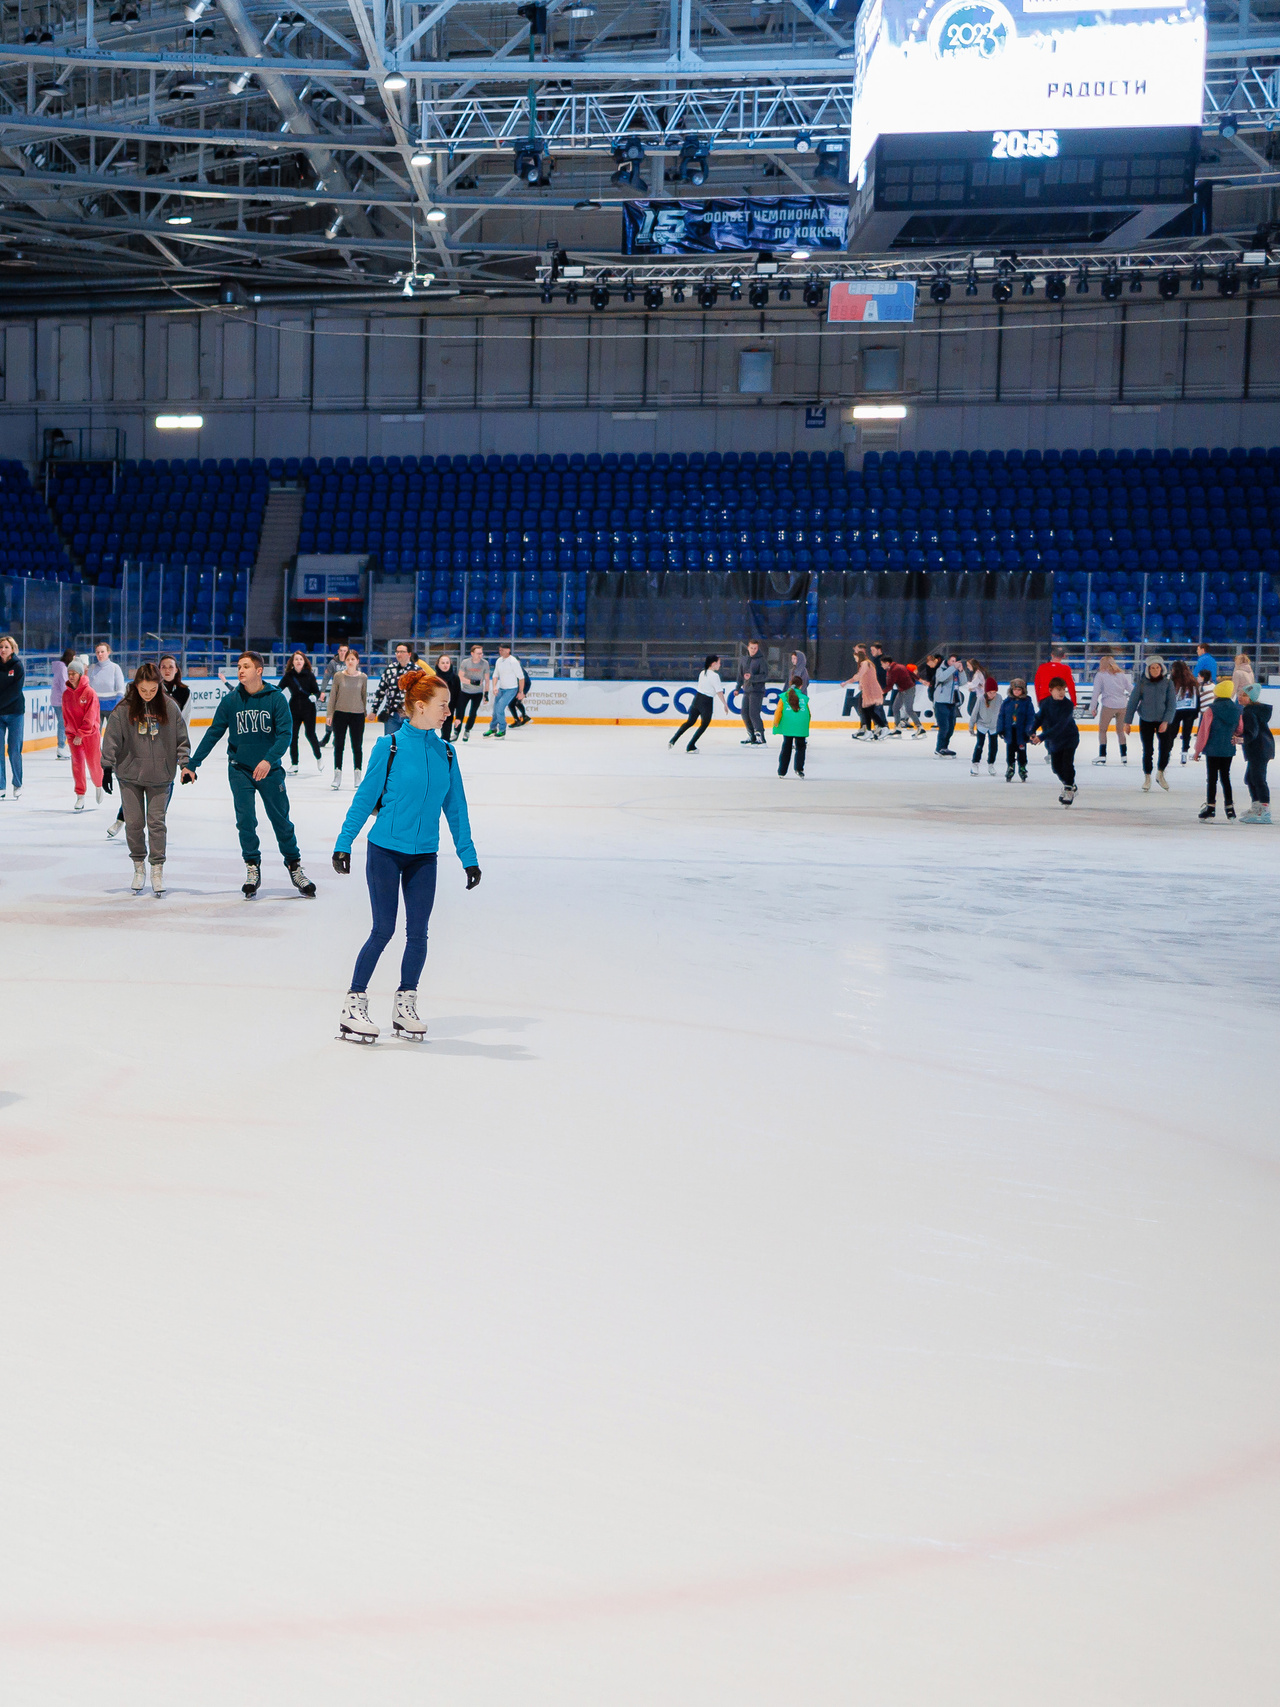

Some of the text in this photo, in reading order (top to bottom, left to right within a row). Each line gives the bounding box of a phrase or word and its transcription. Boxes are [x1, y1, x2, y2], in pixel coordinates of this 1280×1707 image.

[1048, 80, 1146, 98] РАДОСТИ
[992, 130, 1059, 158] 20:55
[754, 208, 824, 222] ЧЕМПИОНАТ
[774, 227, 790, 239] ПО
[191, 690, 218, 703] ркет
[236, 709, 271, 734] NYC
